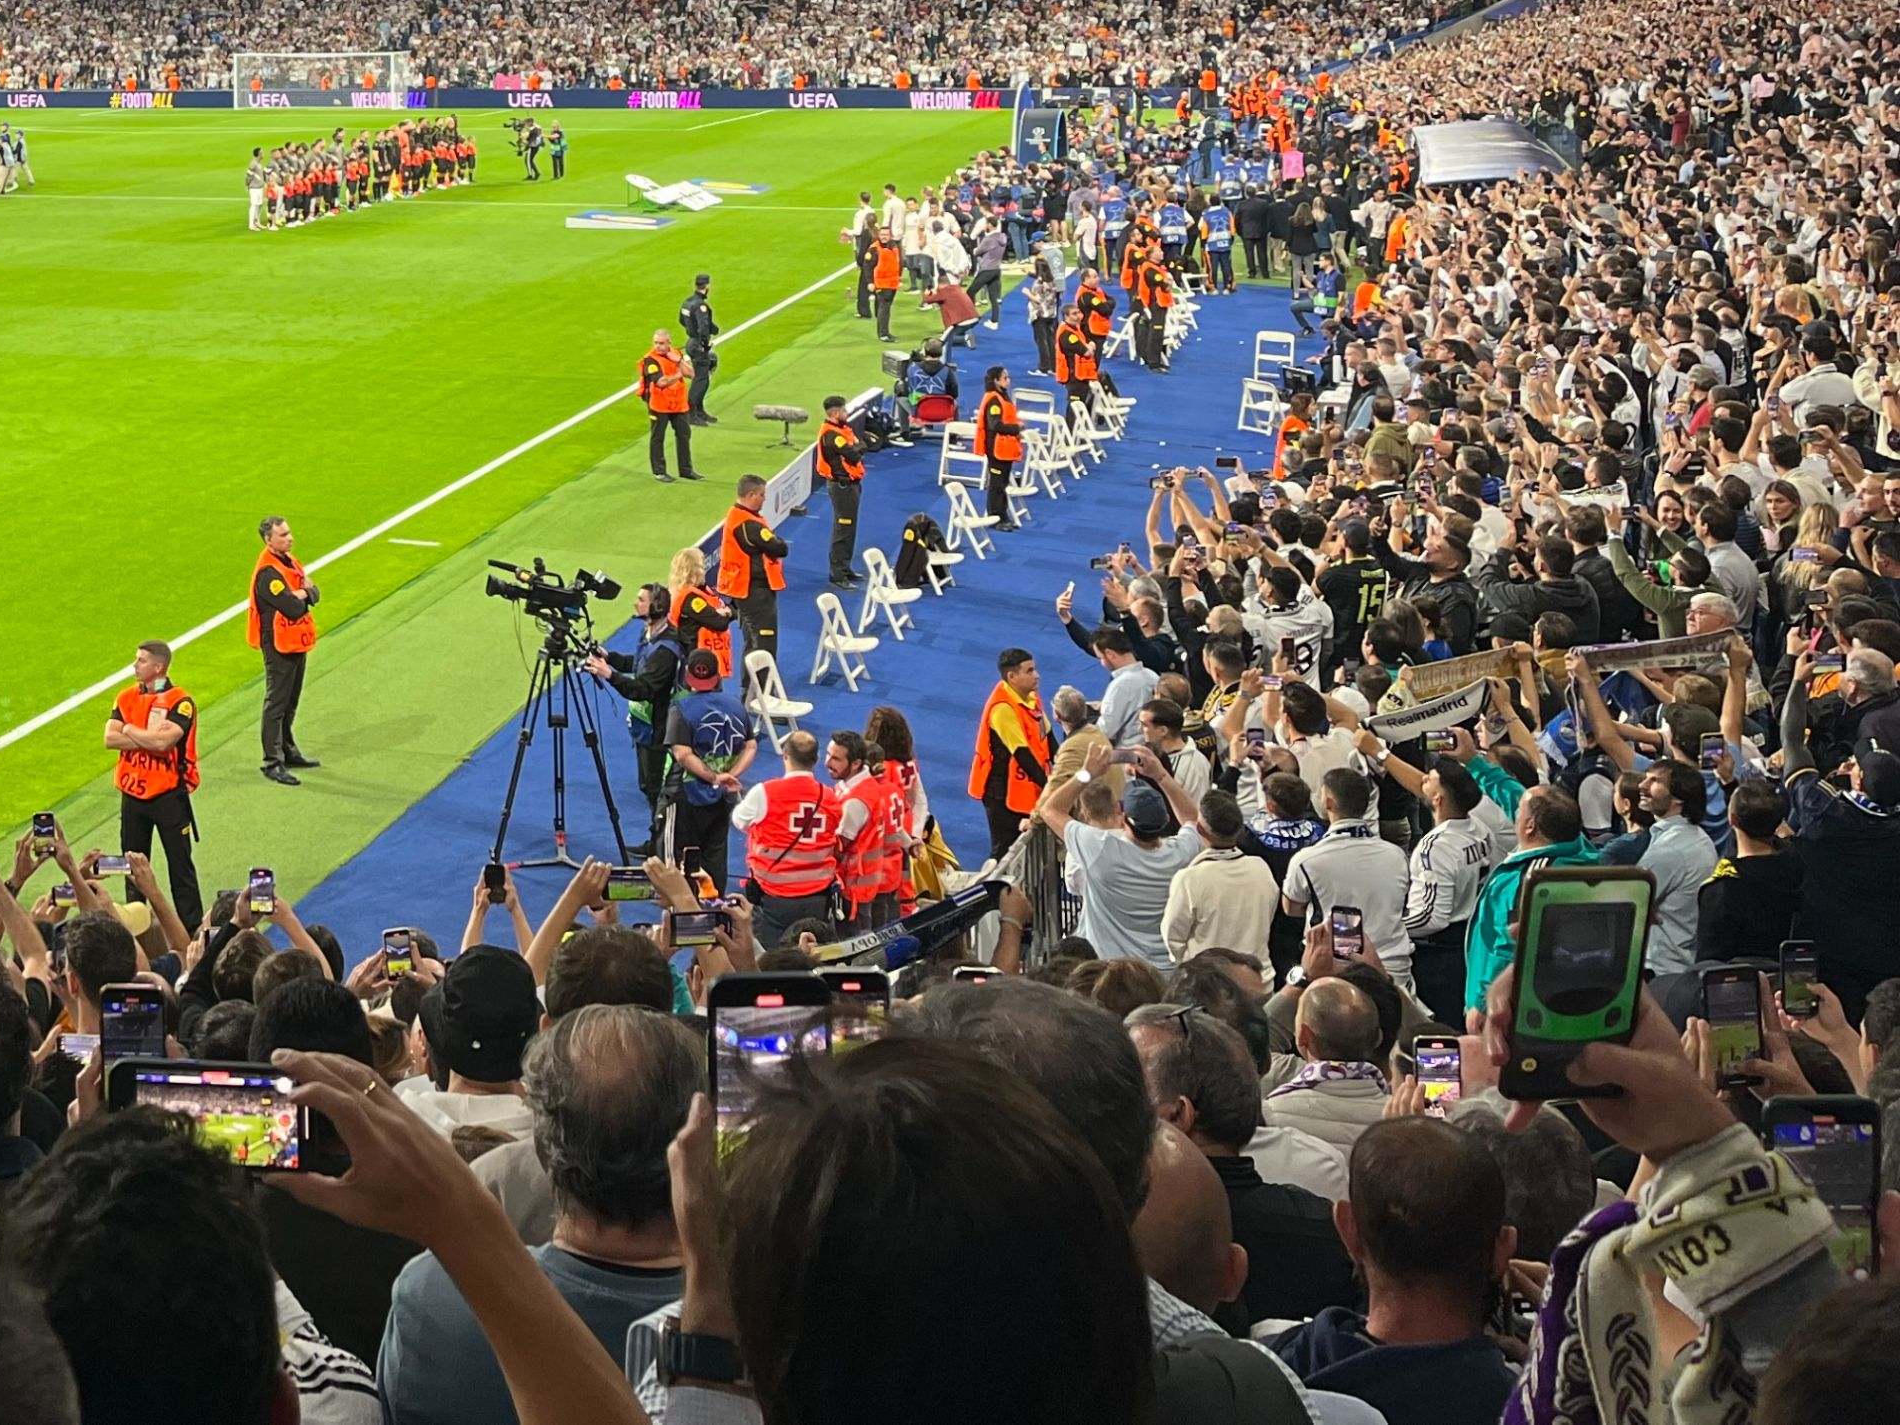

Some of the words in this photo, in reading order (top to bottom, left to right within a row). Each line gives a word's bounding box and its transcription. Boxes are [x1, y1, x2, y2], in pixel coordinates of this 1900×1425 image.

[7, 94, 46, 107] UEFA
[109, 92, 174, 108] #FOOTBALL
[248, 93, 290, 107] UEFA
[405, 92, 427, 108] ALL
[508, 93, 553, 108] UEFA
[627, 91, 701, 109] #FOOTBALL
[789, 93, 838, 108] UEFA
[910, 91, 971, 109] WELCOME
[973, 91, 1000, 109] ALL
[1357, 583, 1386, 624] 15
[1386, 695, 1469, 730] Realmadrid
